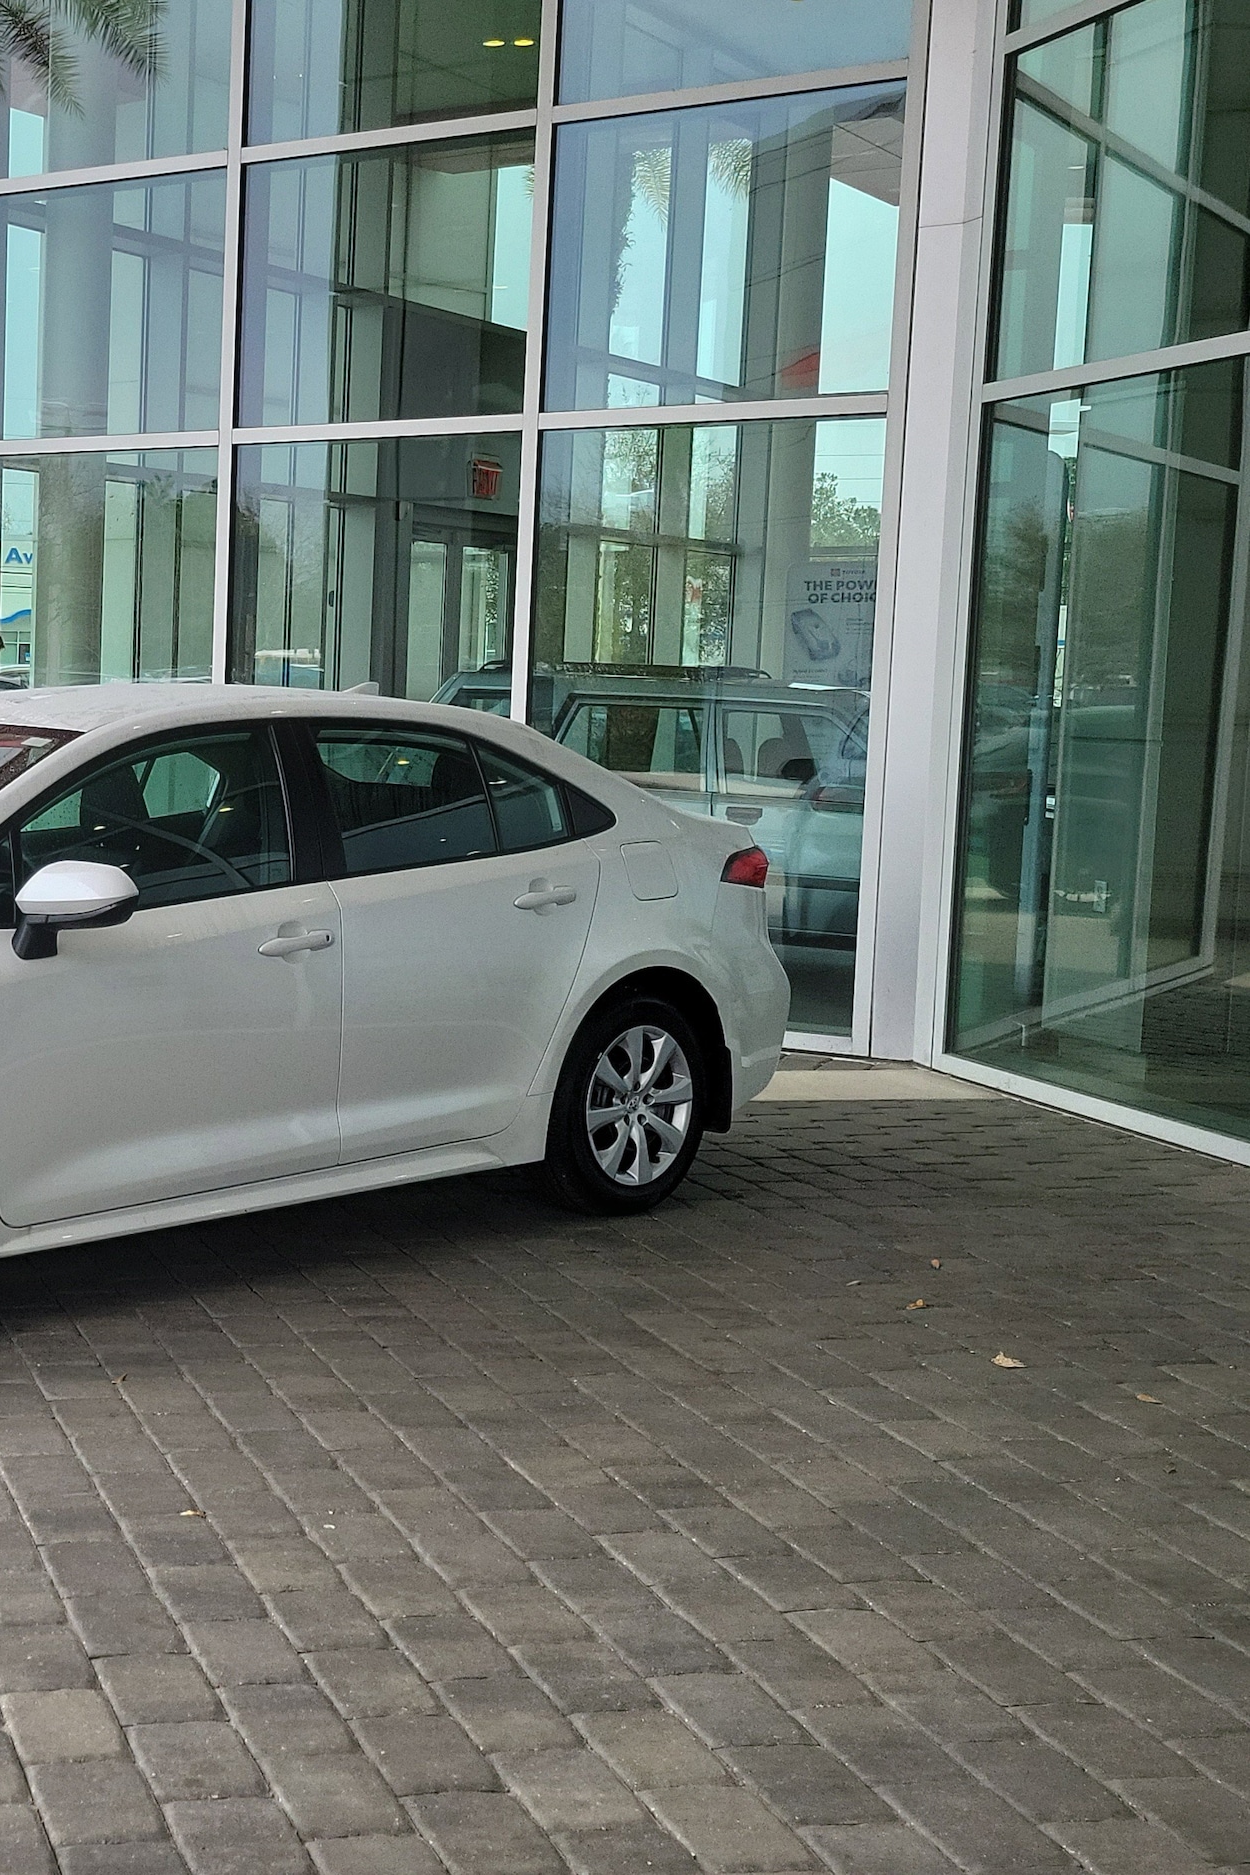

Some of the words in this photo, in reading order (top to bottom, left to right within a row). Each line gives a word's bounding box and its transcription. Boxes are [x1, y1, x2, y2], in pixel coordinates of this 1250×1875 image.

[804, 580, 832, 591] THE
[836, 579, 877, 591] POW
[808, 592, 828, 604] OF
